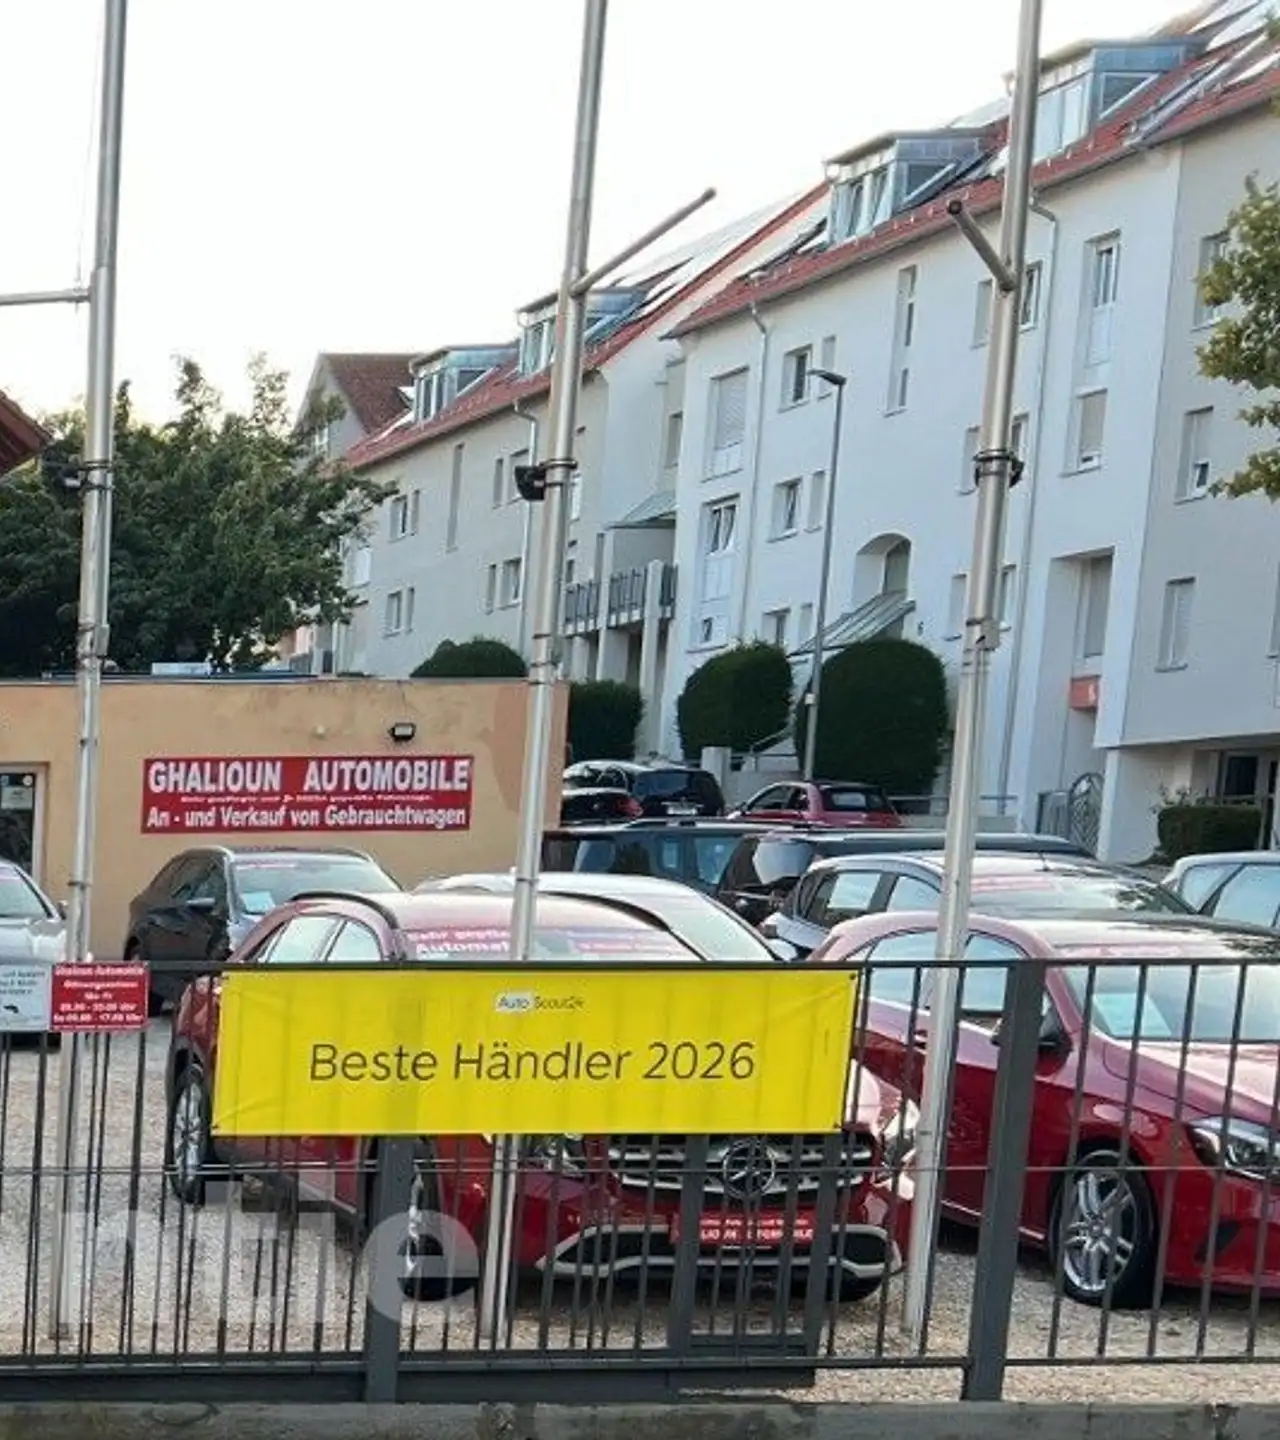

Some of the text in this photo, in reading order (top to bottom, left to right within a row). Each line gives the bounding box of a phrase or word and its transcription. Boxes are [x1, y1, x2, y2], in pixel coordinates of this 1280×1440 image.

[148, 759, 470, 793] GHALIOUN AUTOMOBILE
[147, 807, 169, 827] An
[185, 807, 215, 827] und
[221, 806, 286, 827] Verkauf
[290, 811, 319, 827] von
[324, 805, 466, 829] Gebrauchtwagen
[309, 1041, 756, 1081] Beste Händler 2026
